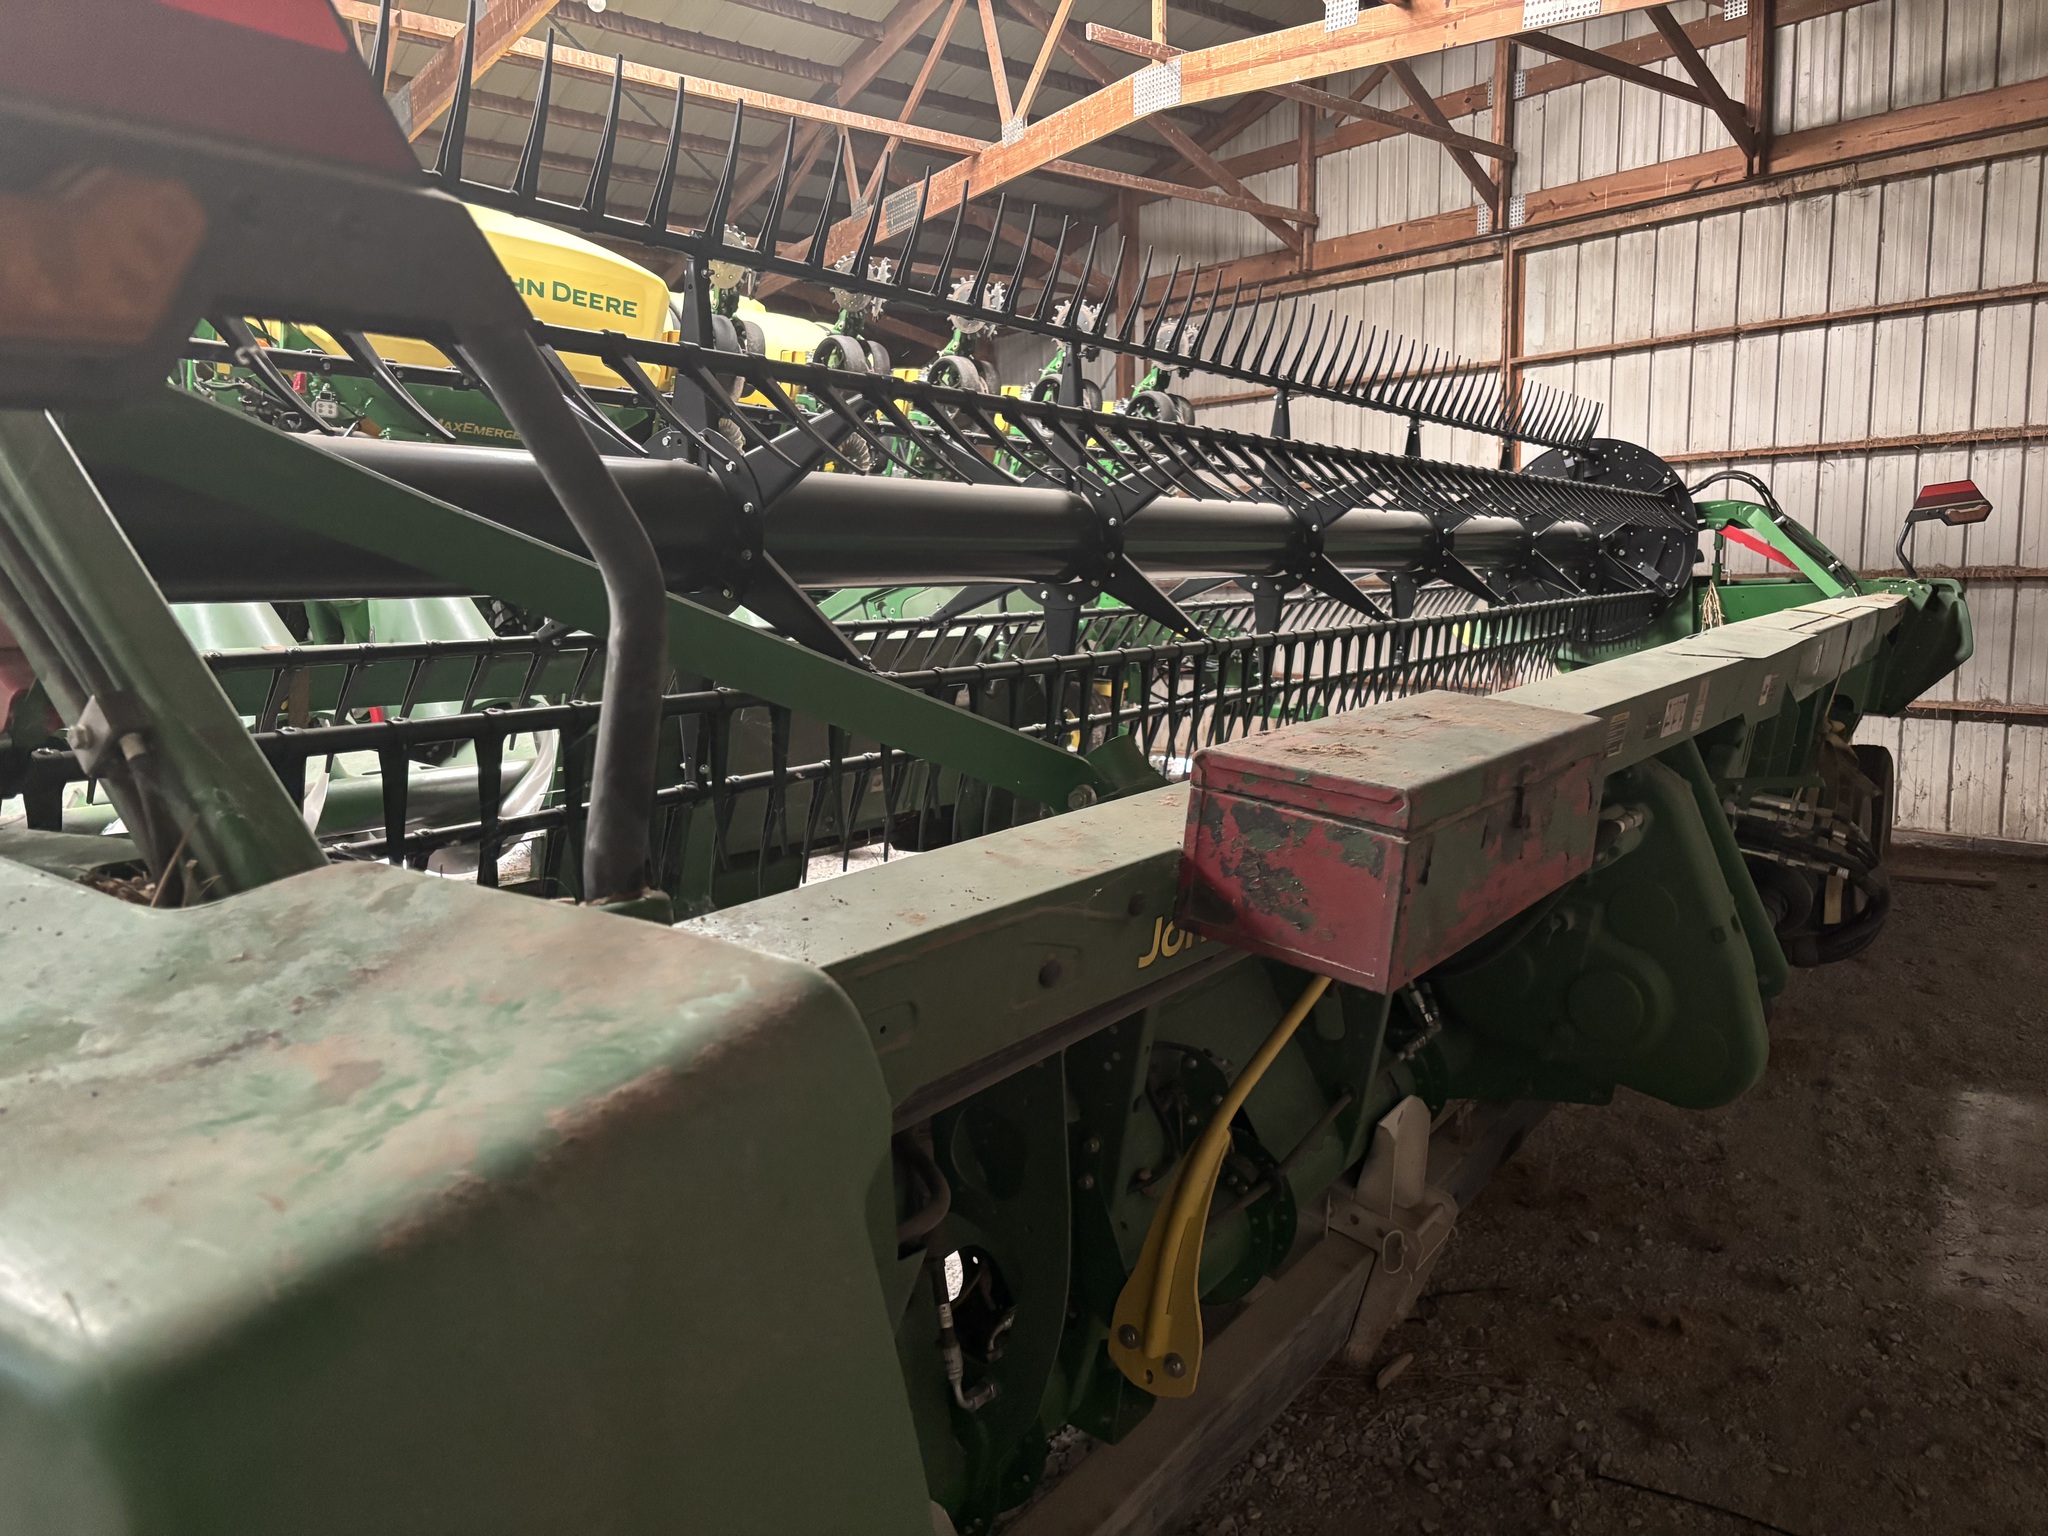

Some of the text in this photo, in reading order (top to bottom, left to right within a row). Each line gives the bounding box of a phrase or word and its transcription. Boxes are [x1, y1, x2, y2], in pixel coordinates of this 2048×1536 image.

[514, 277, 638, 318] HN DEERE
[1137, 916, 1207, 969] JO
